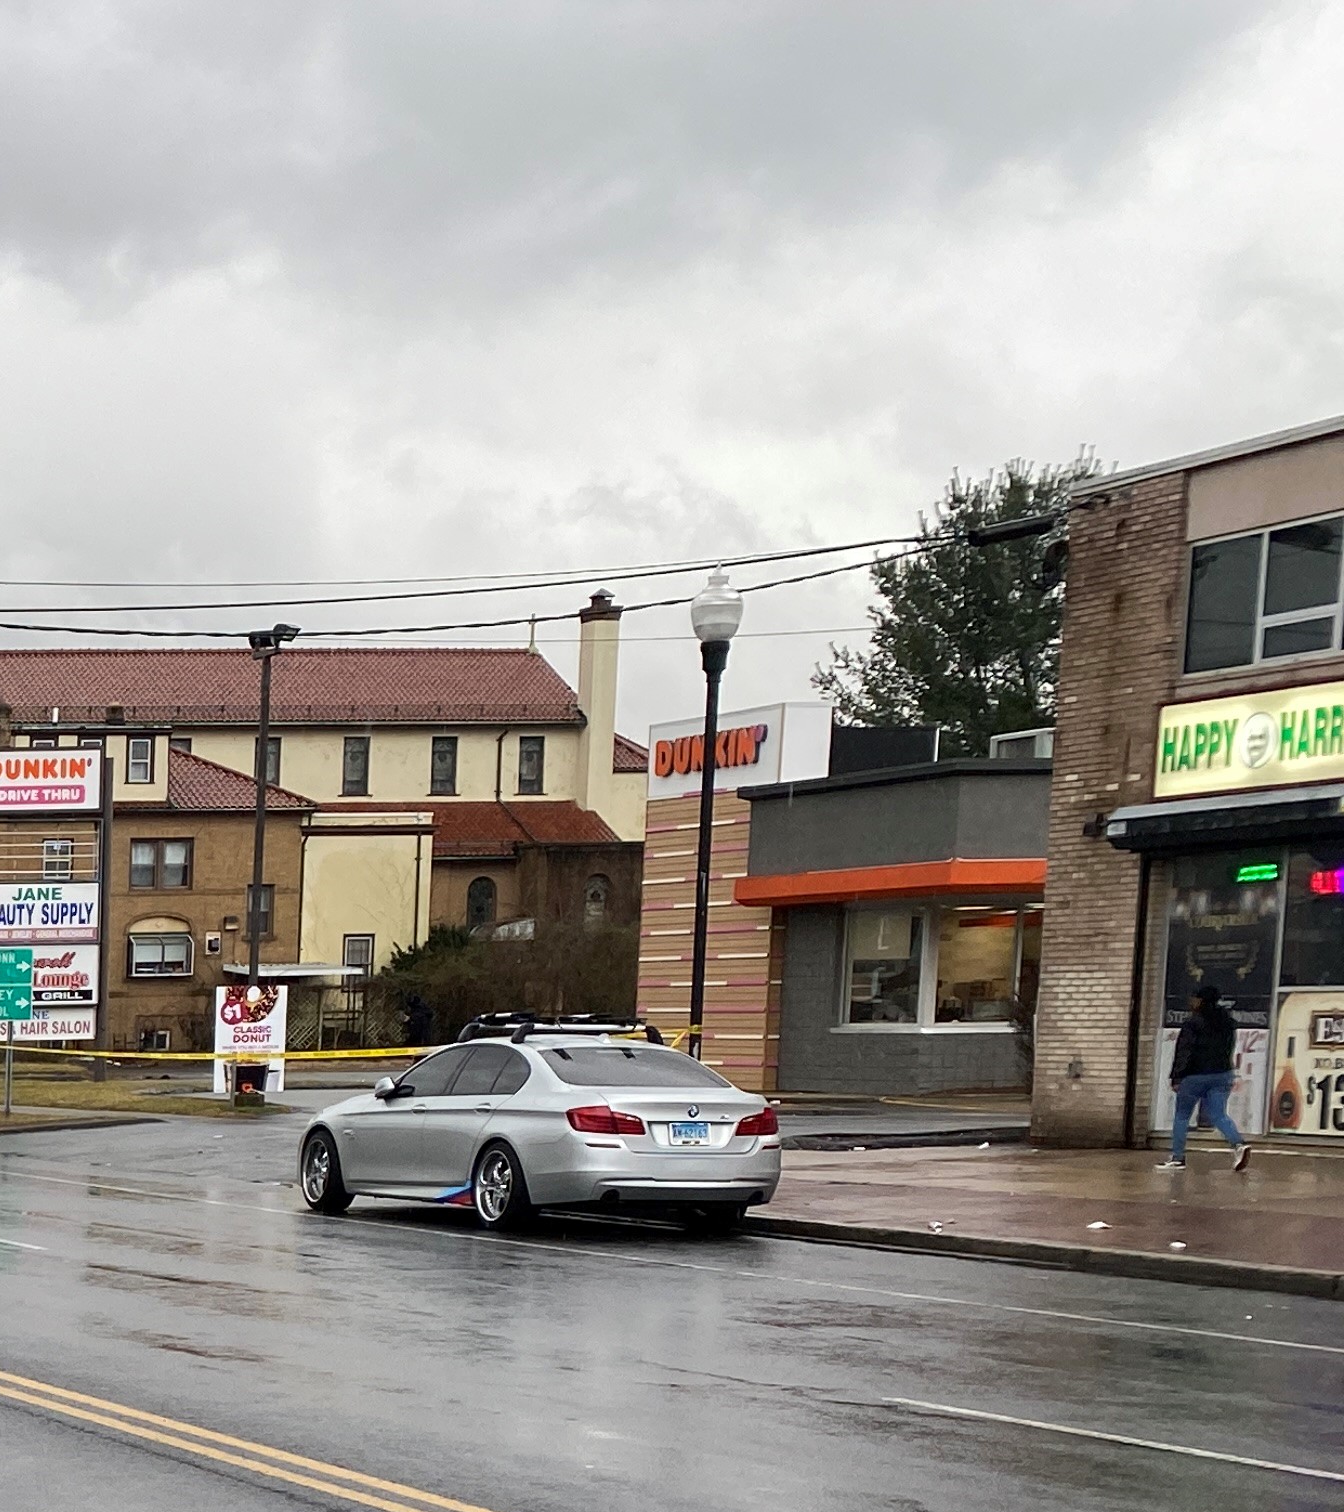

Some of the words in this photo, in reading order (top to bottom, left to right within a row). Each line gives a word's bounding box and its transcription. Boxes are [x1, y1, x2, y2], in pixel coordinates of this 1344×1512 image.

[1161, 718, 1240, 773] HAPPY
[41, 788, 81, 800] THRU
[12, 887, 62, 901] JANE
[41, 902, 94, 924] SUPPLY
[34, 971, 89, 989] Lounge
[41, 991, 83, 1000] GRILL
[224, 1003, 242, 1020] $1
[20, 1022, 48, 1035] HAIR
[51, 1020, 90, 1035] SALON
[233, 1026, 272, 1034] CLASSIC
[233, 1034, 271, 1043] DONUT
